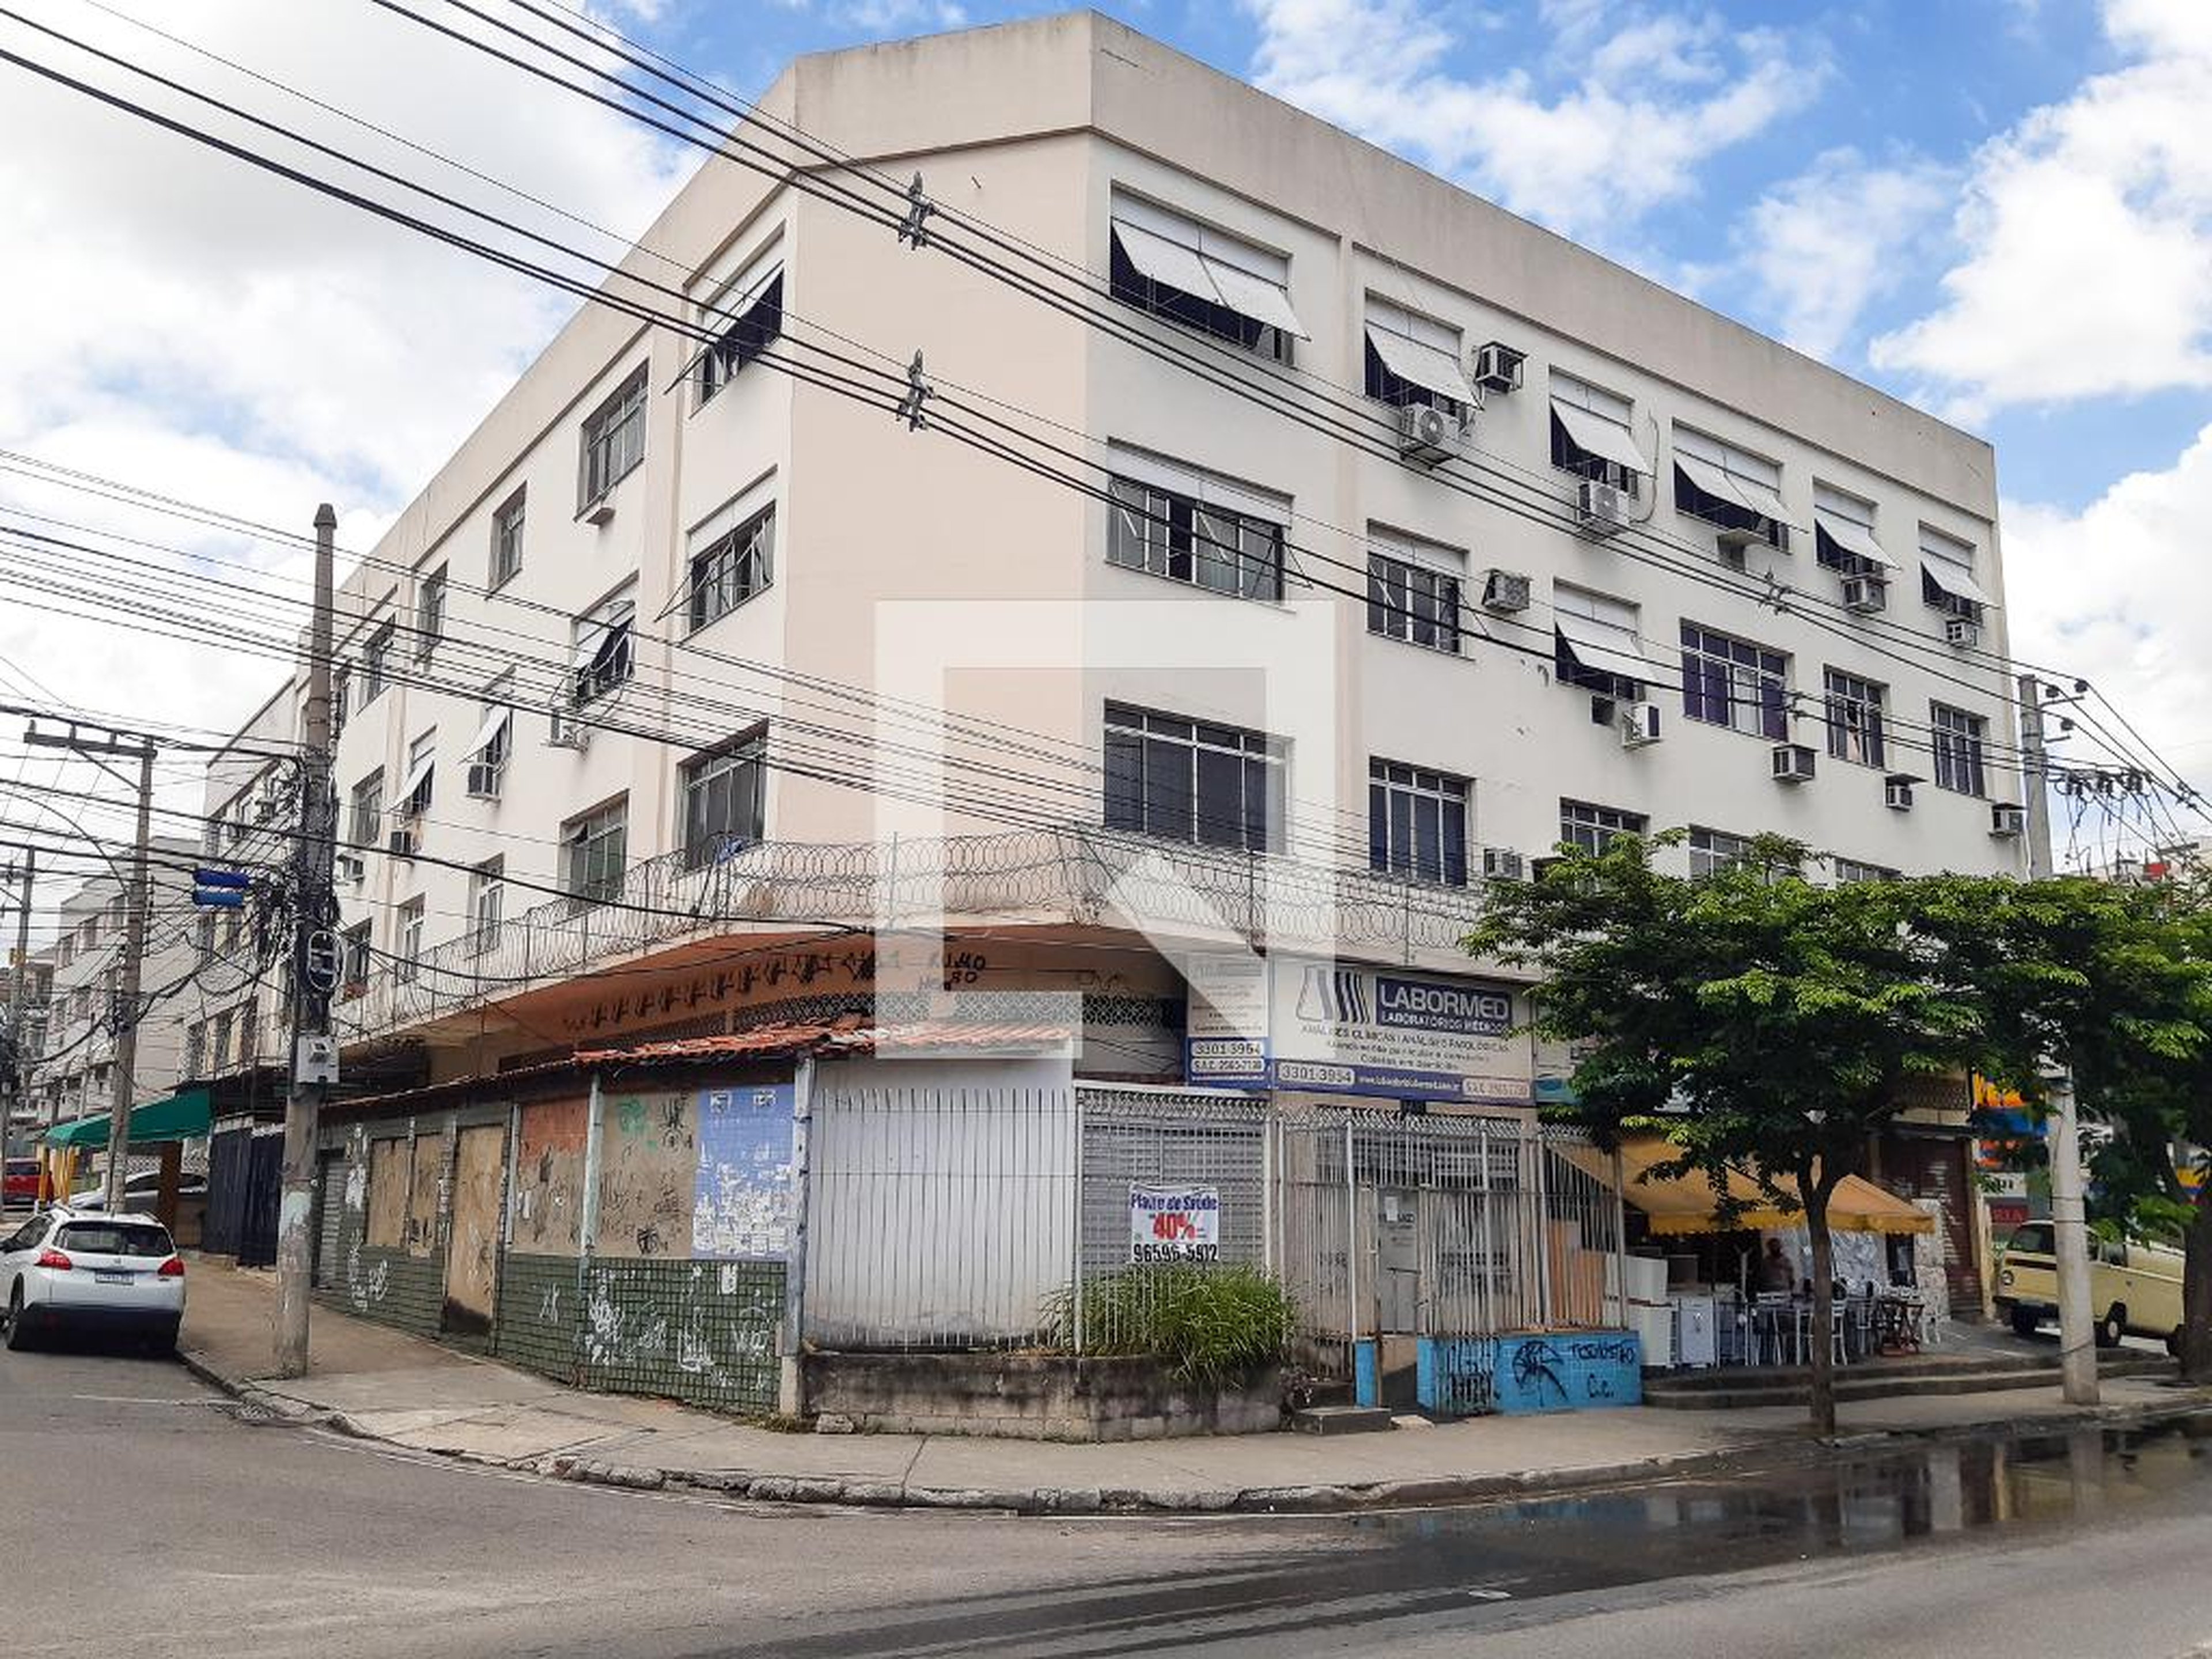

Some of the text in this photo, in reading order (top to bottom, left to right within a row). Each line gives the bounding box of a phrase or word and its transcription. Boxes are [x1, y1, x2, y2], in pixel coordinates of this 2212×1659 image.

[1380, 984, 1508, 1020] LABORMED
[1166, 1195, 1181, 1210] de
[1153, 1211, 1196, 1240] 40%
